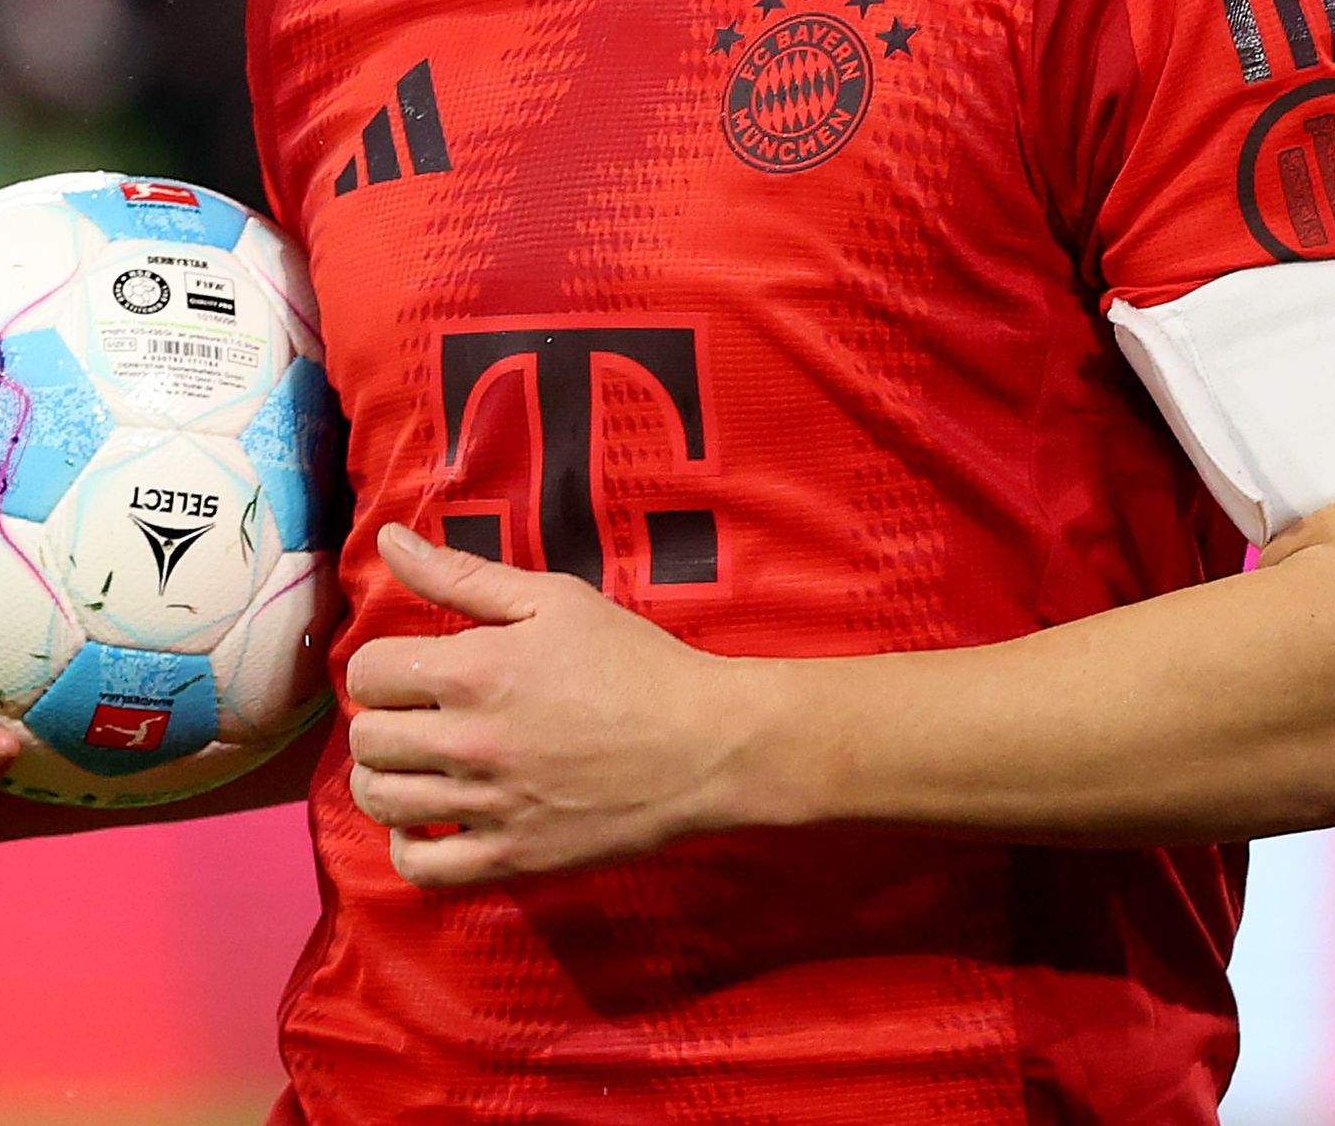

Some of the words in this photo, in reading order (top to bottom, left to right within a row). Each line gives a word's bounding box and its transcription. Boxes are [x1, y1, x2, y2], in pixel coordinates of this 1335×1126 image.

[740, 46, 771, 82] FC
[776, 25, 862, 83] BAYERN
[730, 107, 854, 161] MÜNCHEN
[147, 256, 209, 269] DERBYSTAR
[441, 327, 719, 593] T
[129, 486, 219, 518] SELECT
